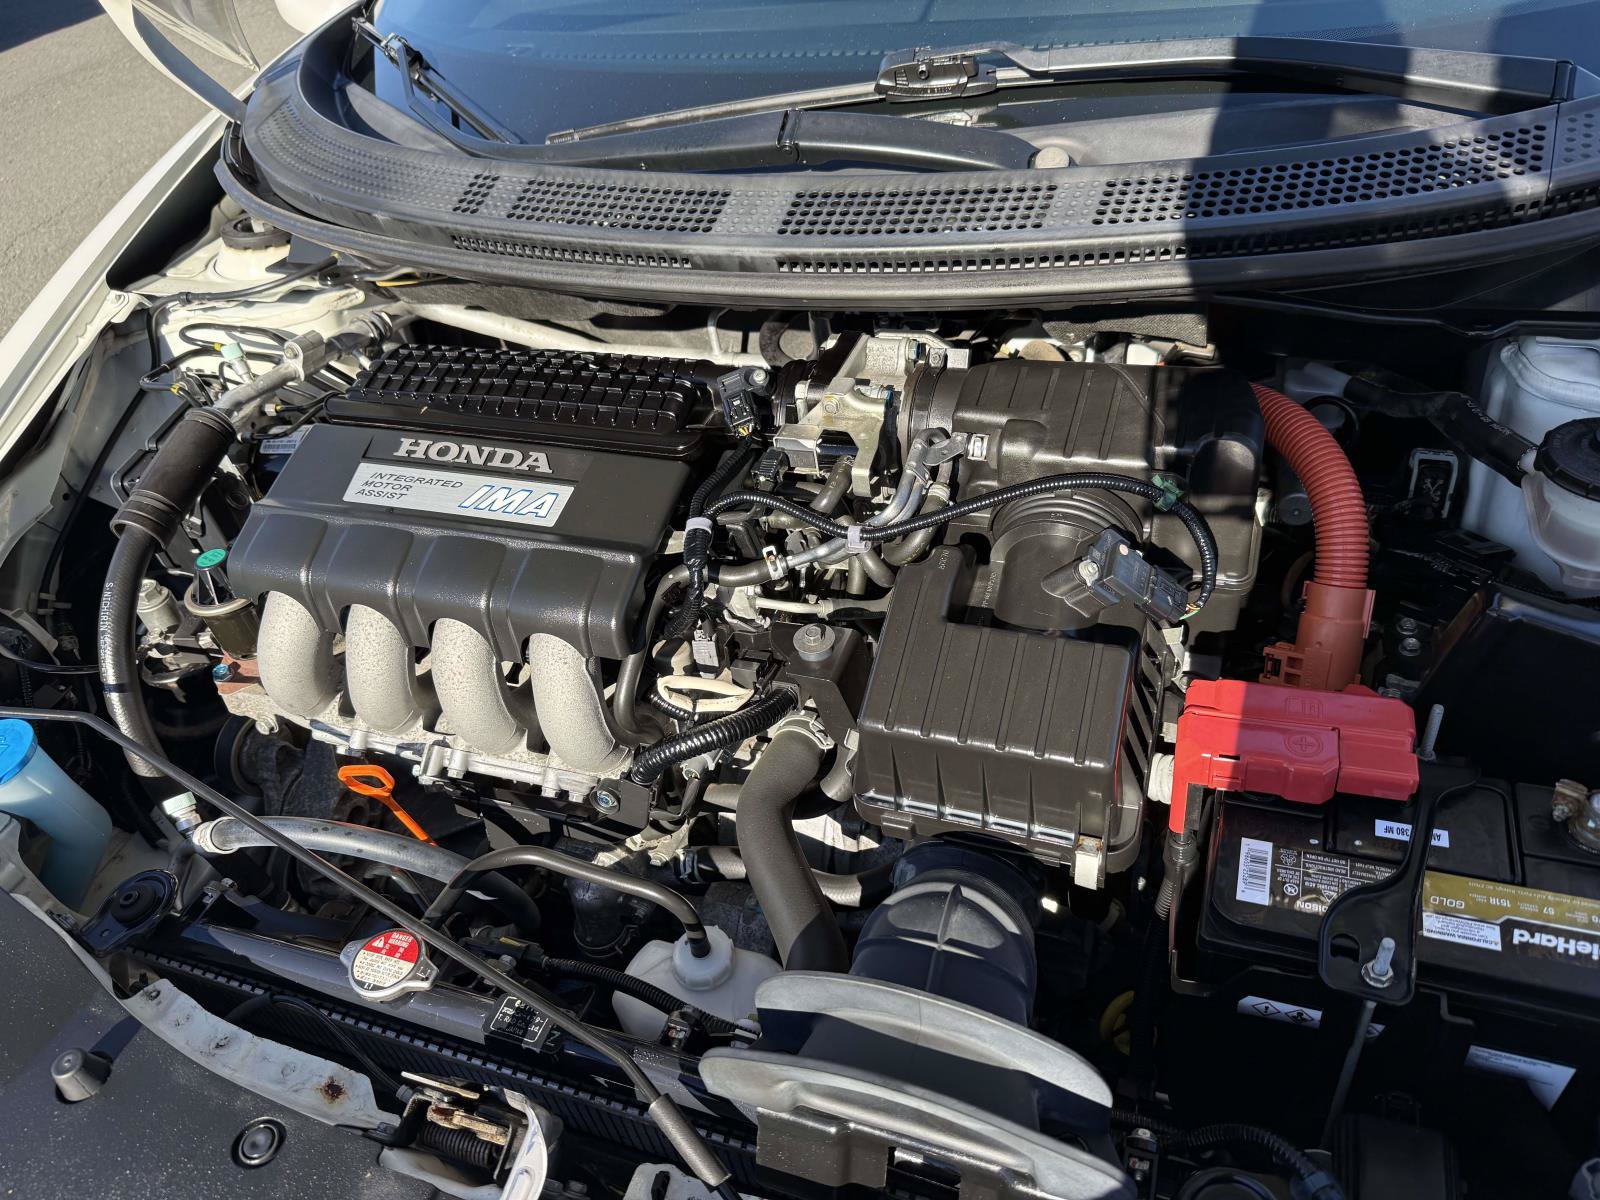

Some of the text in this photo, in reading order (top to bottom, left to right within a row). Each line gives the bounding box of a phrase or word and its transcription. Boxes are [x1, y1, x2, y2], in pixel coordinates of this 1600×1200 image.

[393, 438, 553, 474] HONDA
[361, 480, 413, 492] MOTOR
[369, 471, 464, 488] INTEGRATED
[355, 488, 408, 500] ASSIST
[457, 484, 560, 519] IMA
[1384, 826, 1394, 834] MF
[1430, 895, 1465, 909] GOLD
[1455, 933, 1492, 945] CALIFORNIA
[1512, 928, 1600, 961] ieHard
